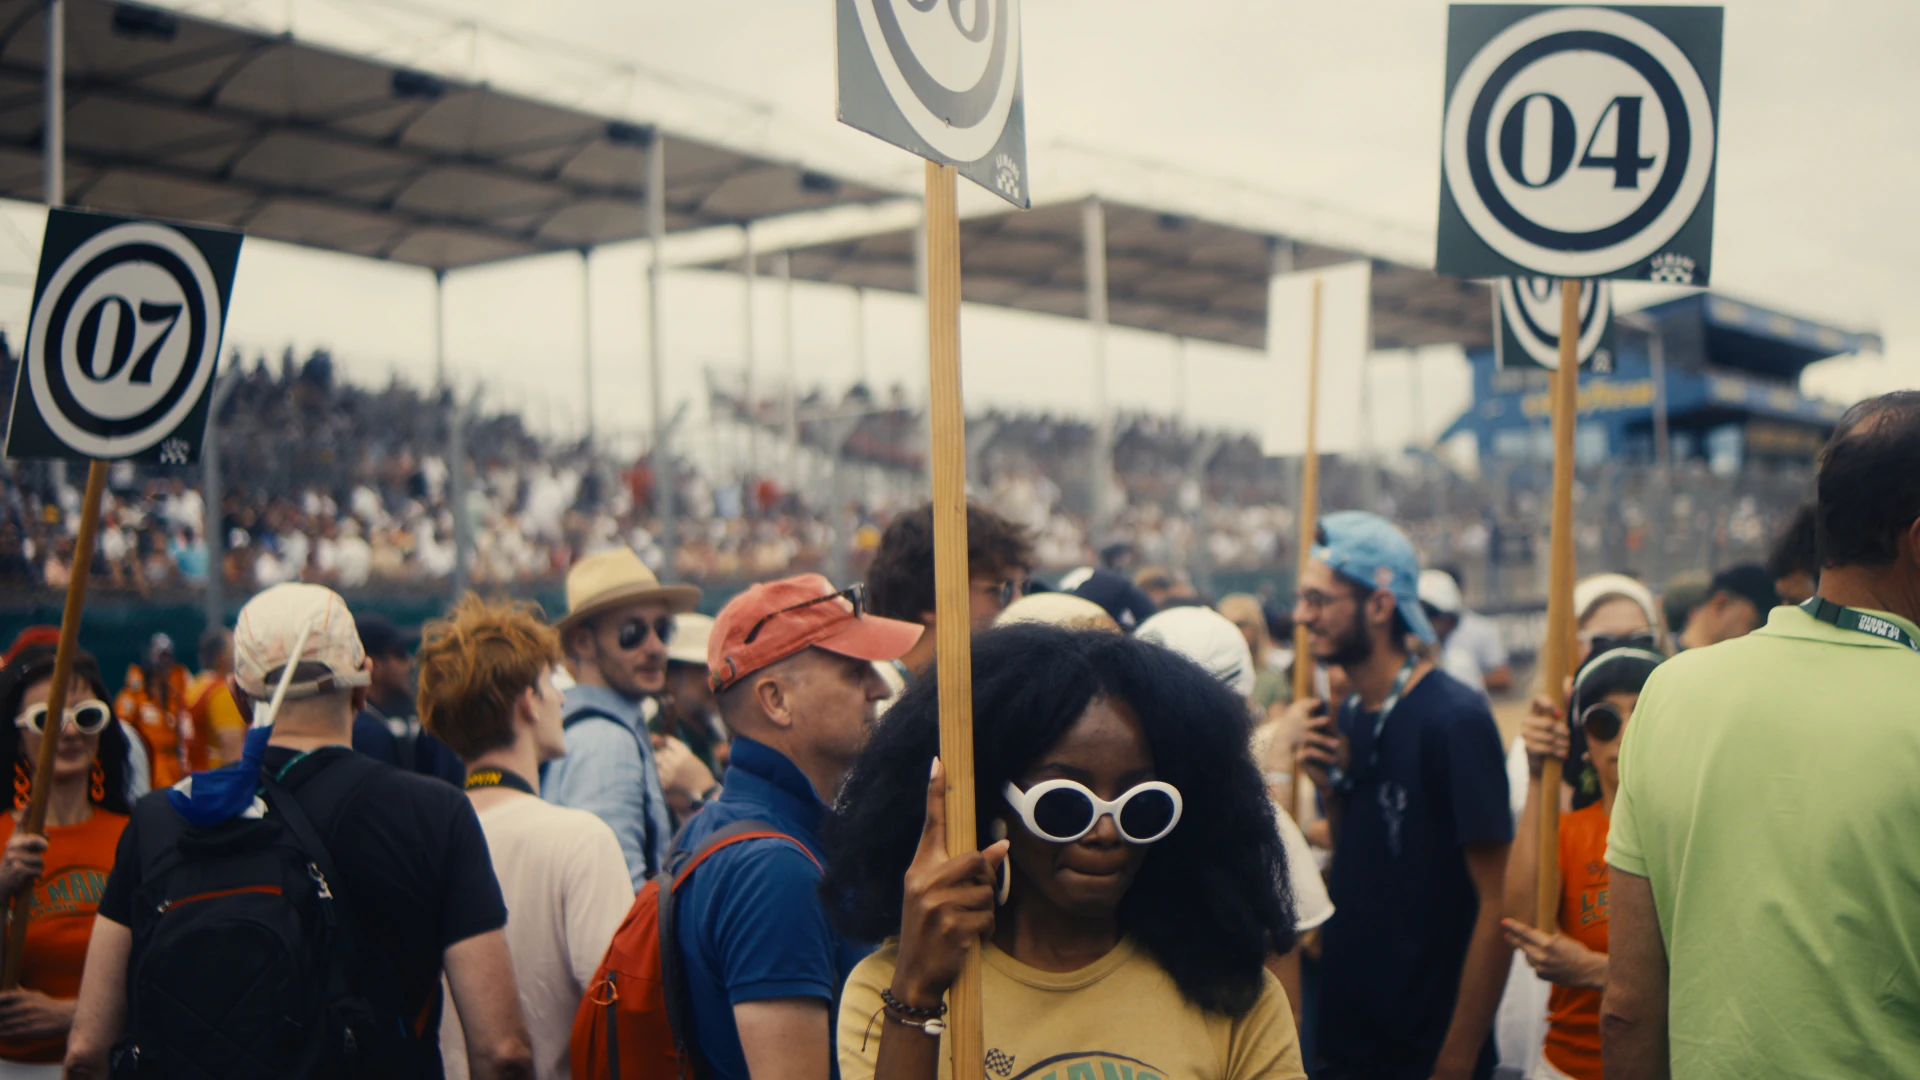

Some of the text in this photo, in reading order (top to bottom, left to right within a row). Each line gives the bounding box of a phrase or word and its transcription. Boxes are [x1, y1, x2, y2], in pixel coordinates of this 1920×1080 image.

[1499, 91, 1657, 190] 04
[75, 295, 183, 385] 07
[47, 868, 109, 906] MAN
